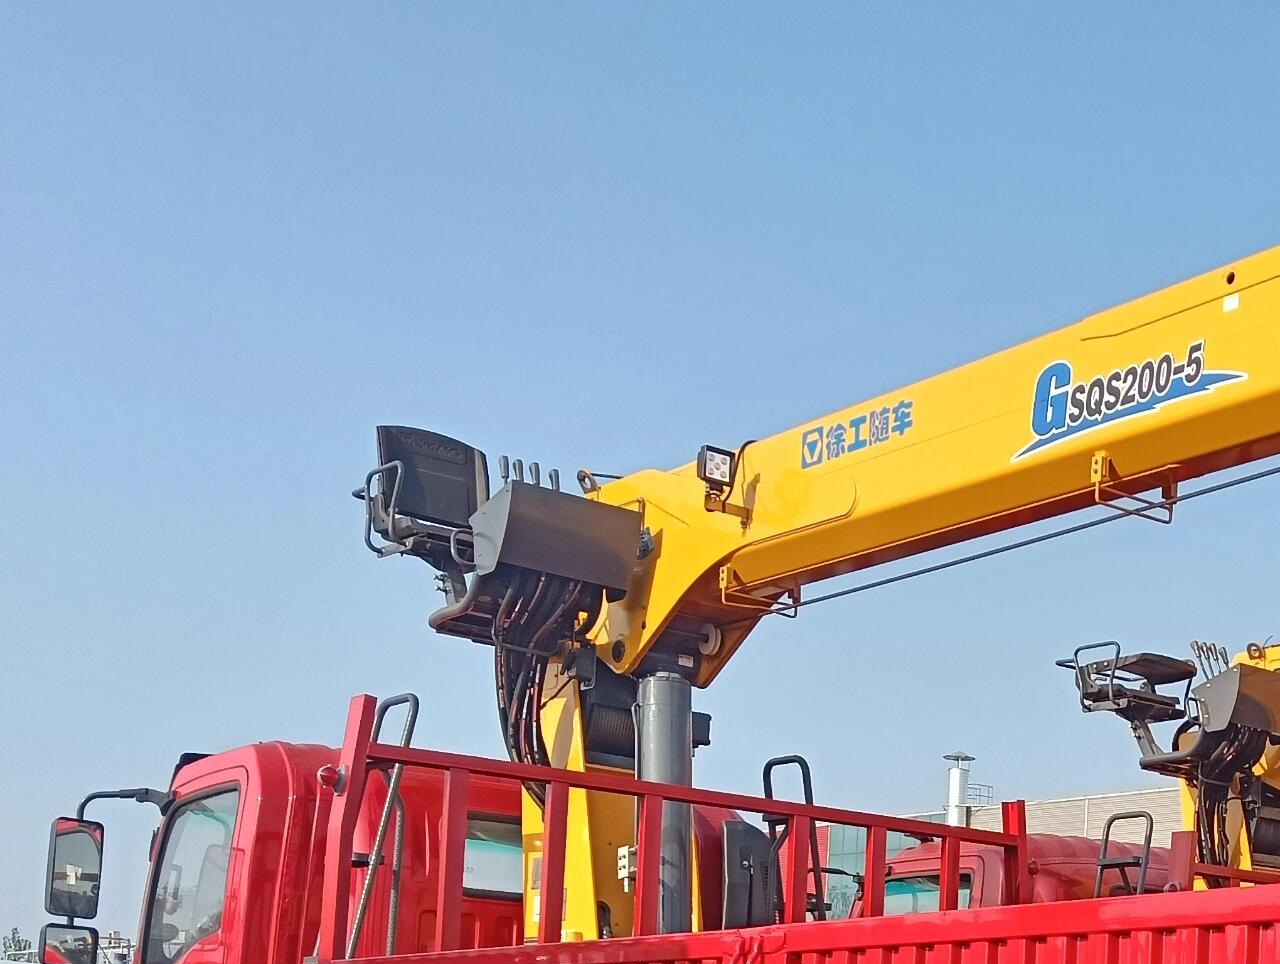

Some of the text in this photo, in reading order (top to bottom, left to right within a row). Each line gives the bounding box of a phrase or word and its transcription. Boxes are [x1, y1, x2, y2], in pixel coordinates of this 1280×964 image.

[1032, 341, 1203, 437] GSQS200-5
[826, 400, 913, 460] 徐工随车
